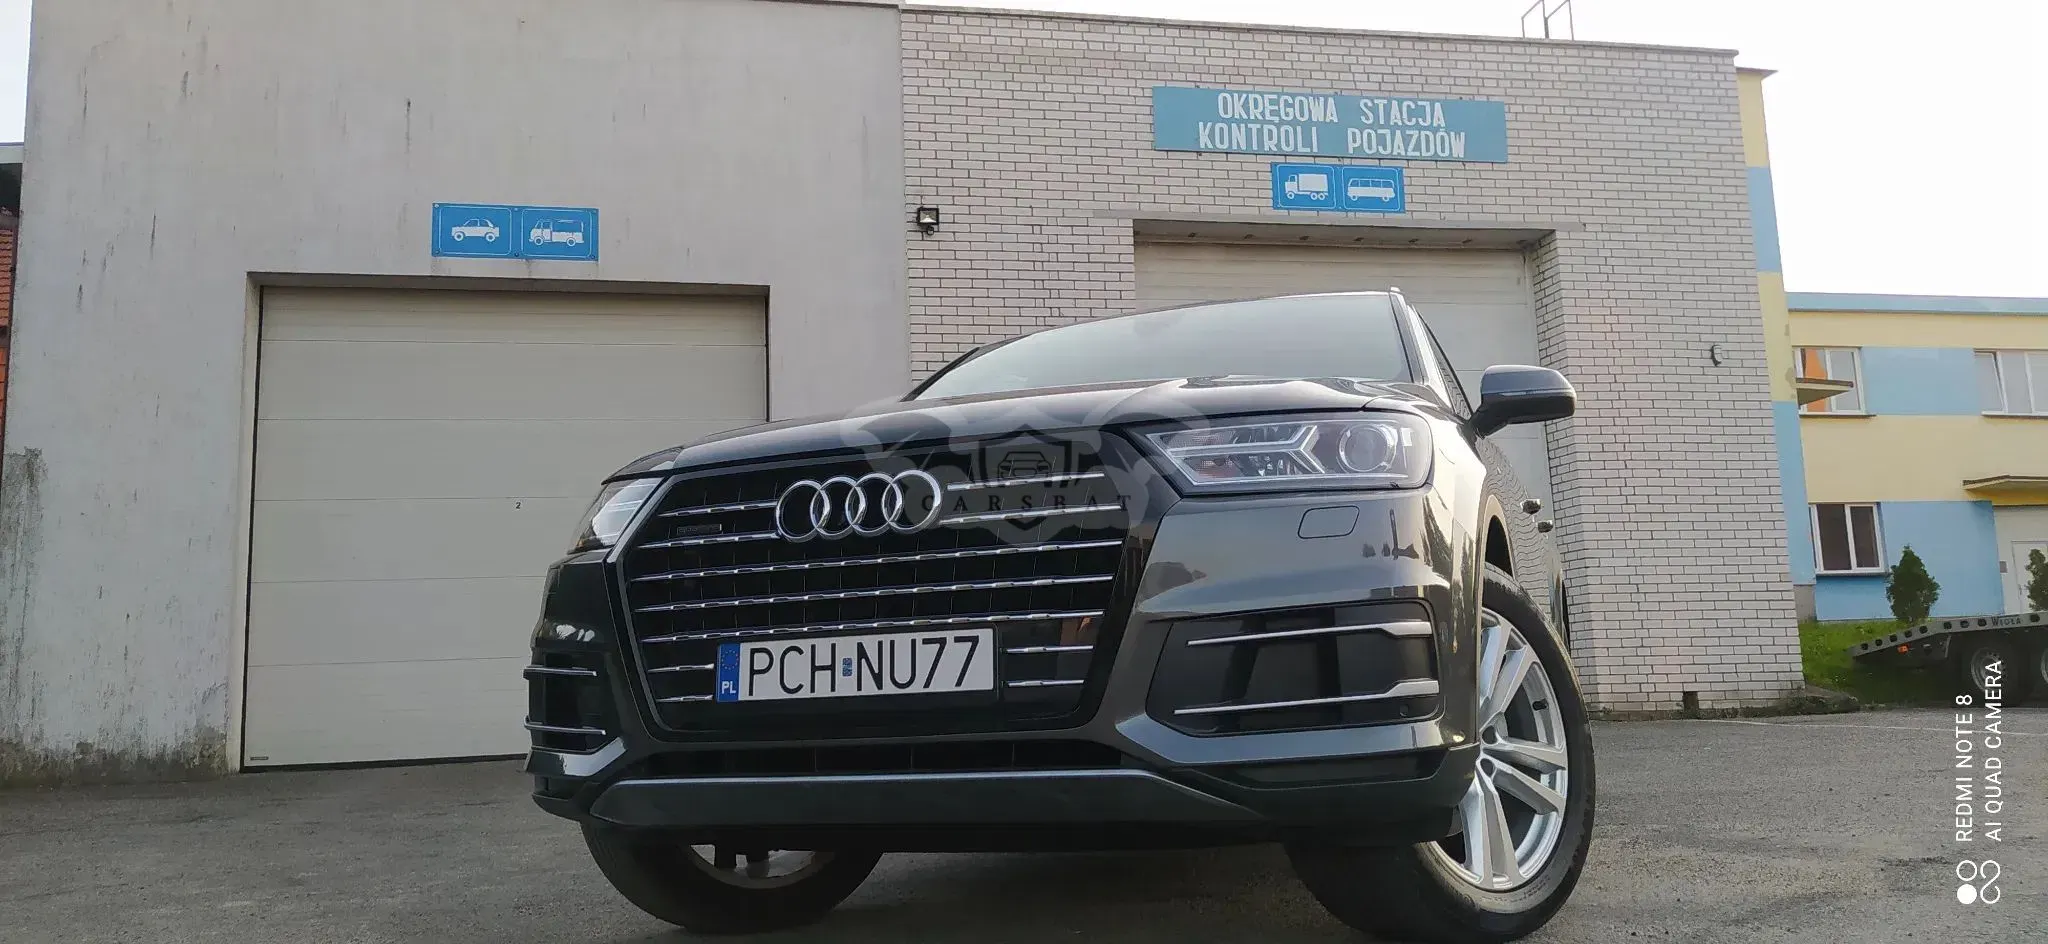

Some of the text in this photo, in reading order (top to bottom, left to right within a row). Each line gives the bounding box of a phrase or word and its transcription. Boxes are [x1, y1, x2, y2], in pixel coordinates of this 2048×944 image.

[1217, 92, 1446, 127] OKRĘGOWA STACJA
[1199, 122, 1466, 158] KONTROLI POJAZDÓW
[516, 501, 521, 509] 2
[748, 635, 980, 697] PCH NU77
[721, 681, 737, 694] PL
